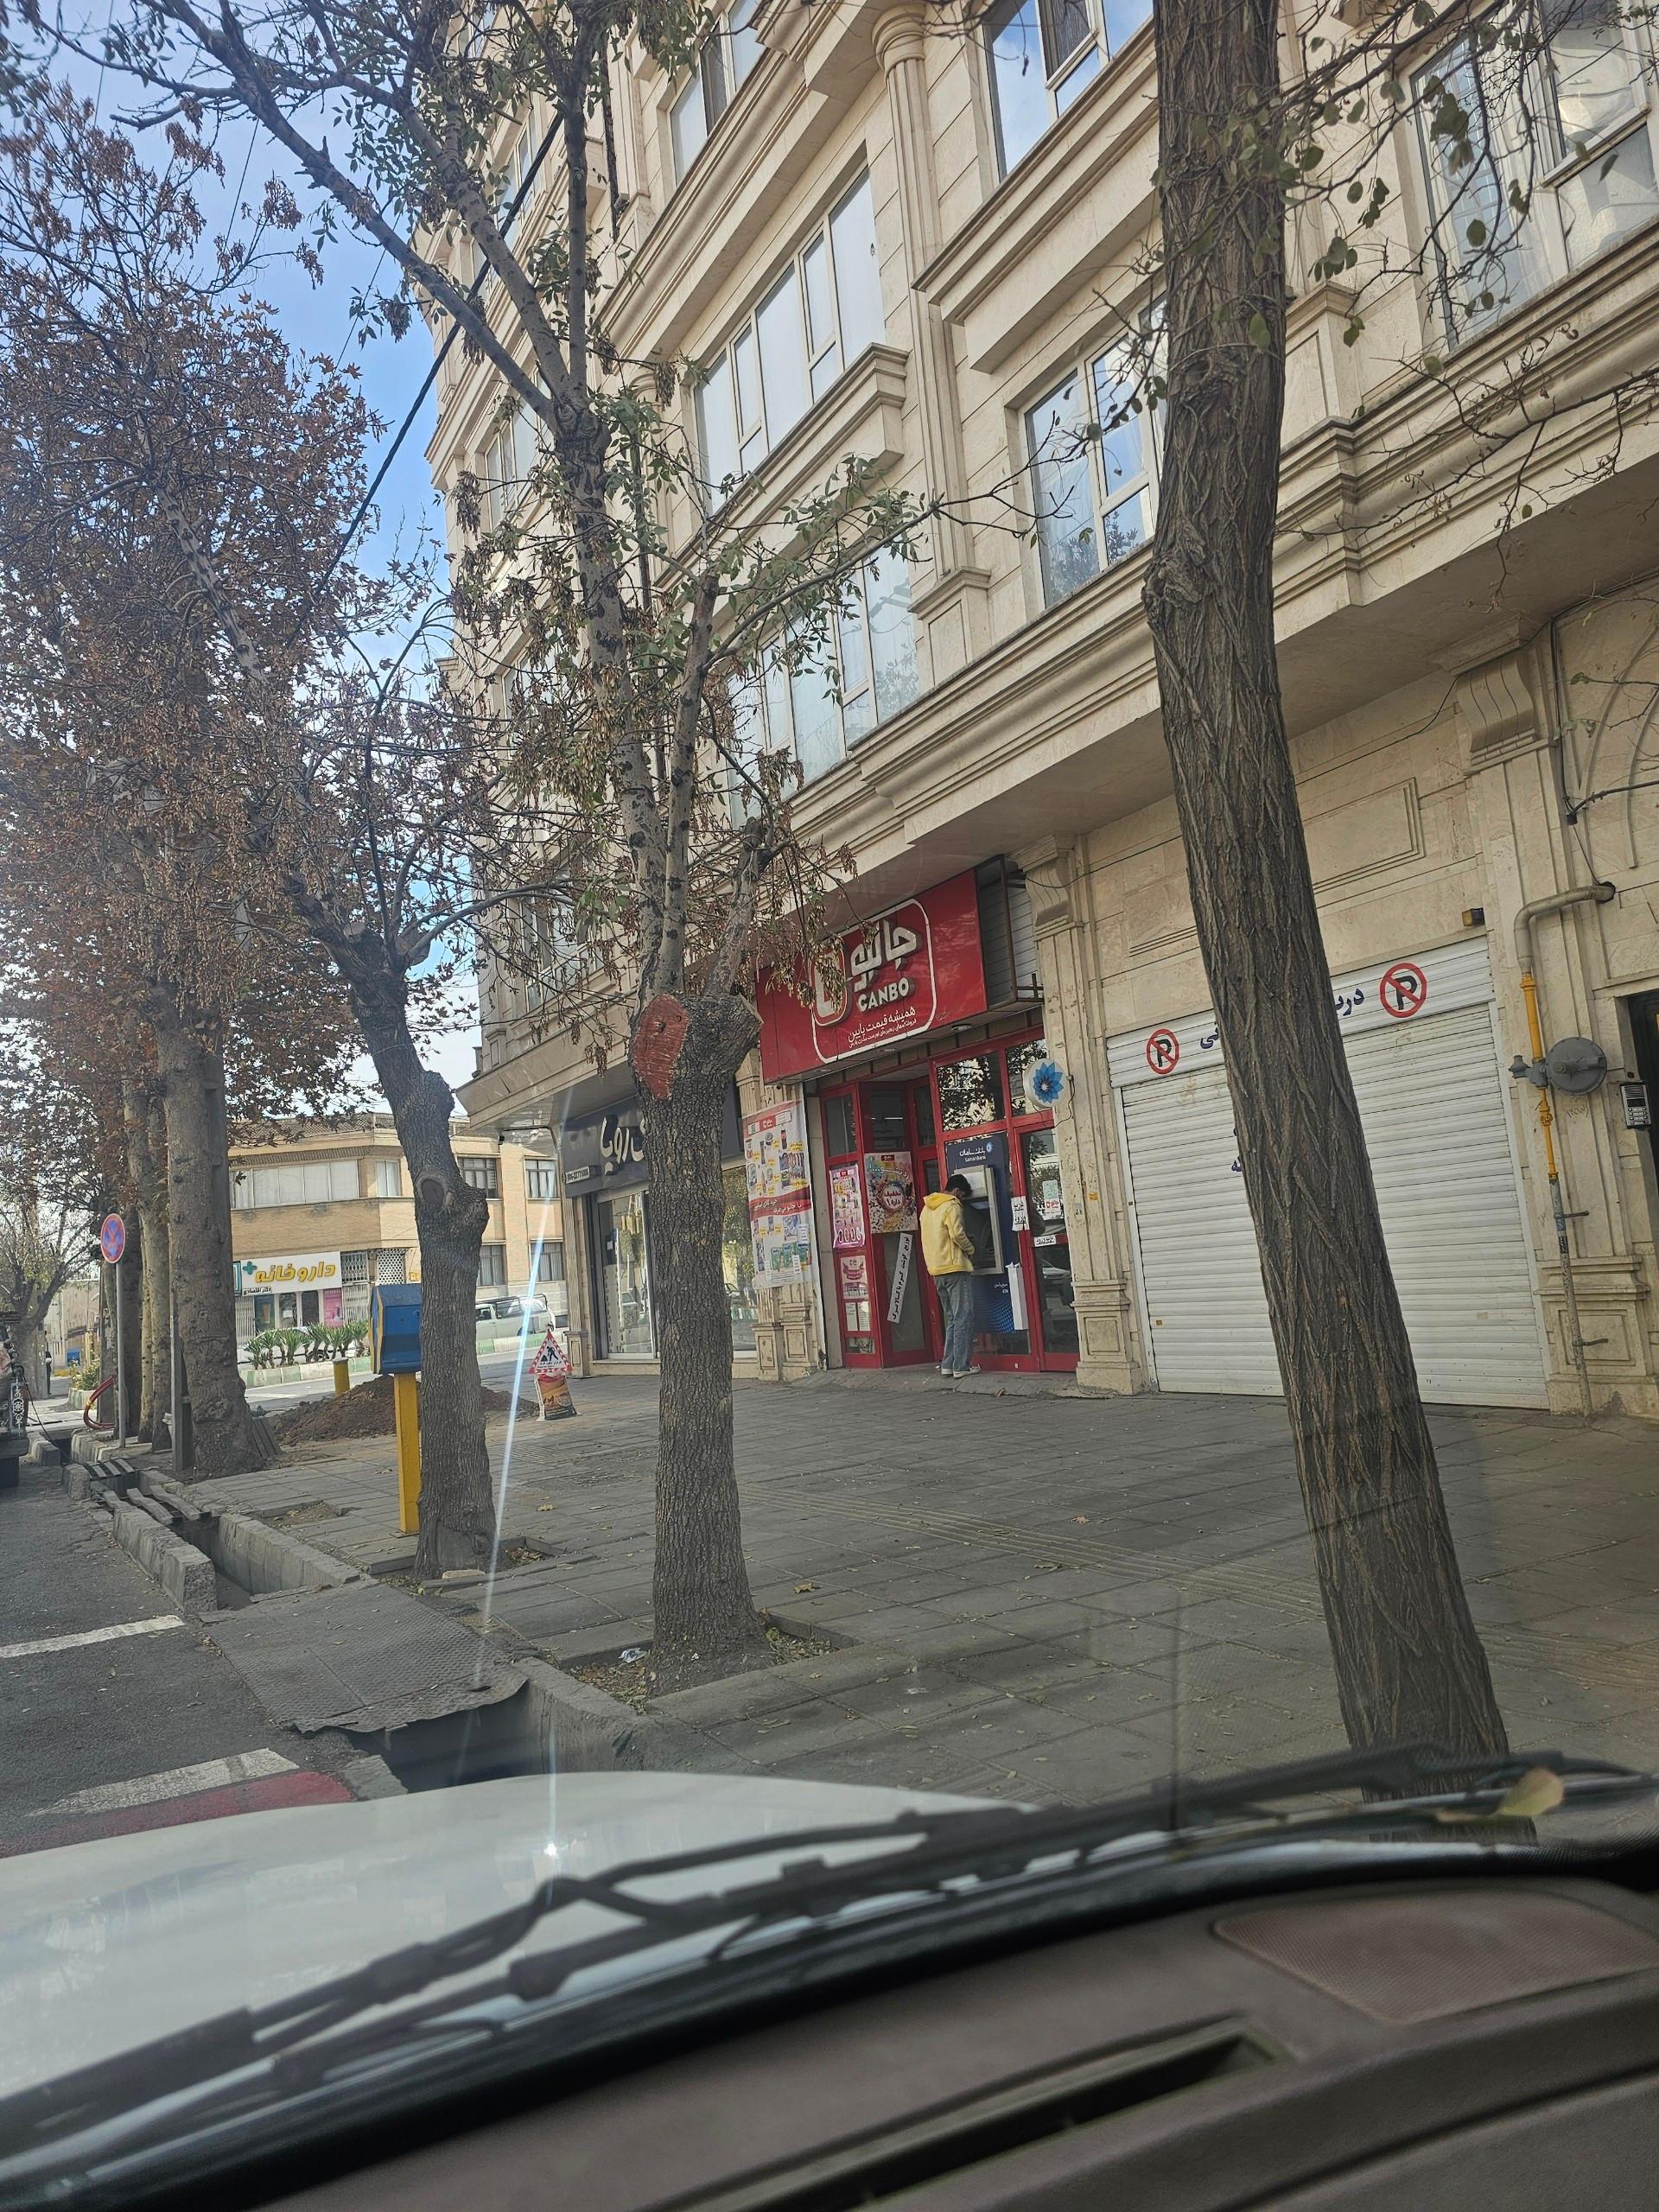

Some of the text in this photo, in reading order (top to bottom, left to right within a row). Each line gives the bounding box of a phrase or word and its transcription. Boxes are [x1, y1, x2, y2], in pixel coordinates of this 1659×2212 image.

[857, 977, 910, 1012] CANBO
[848, 1006, 916, 1043] همیشه قیمت پایین
[959, 1146, 986, 1156] بانک سامان
[255, 1262, 336, 1283] داروخانه
